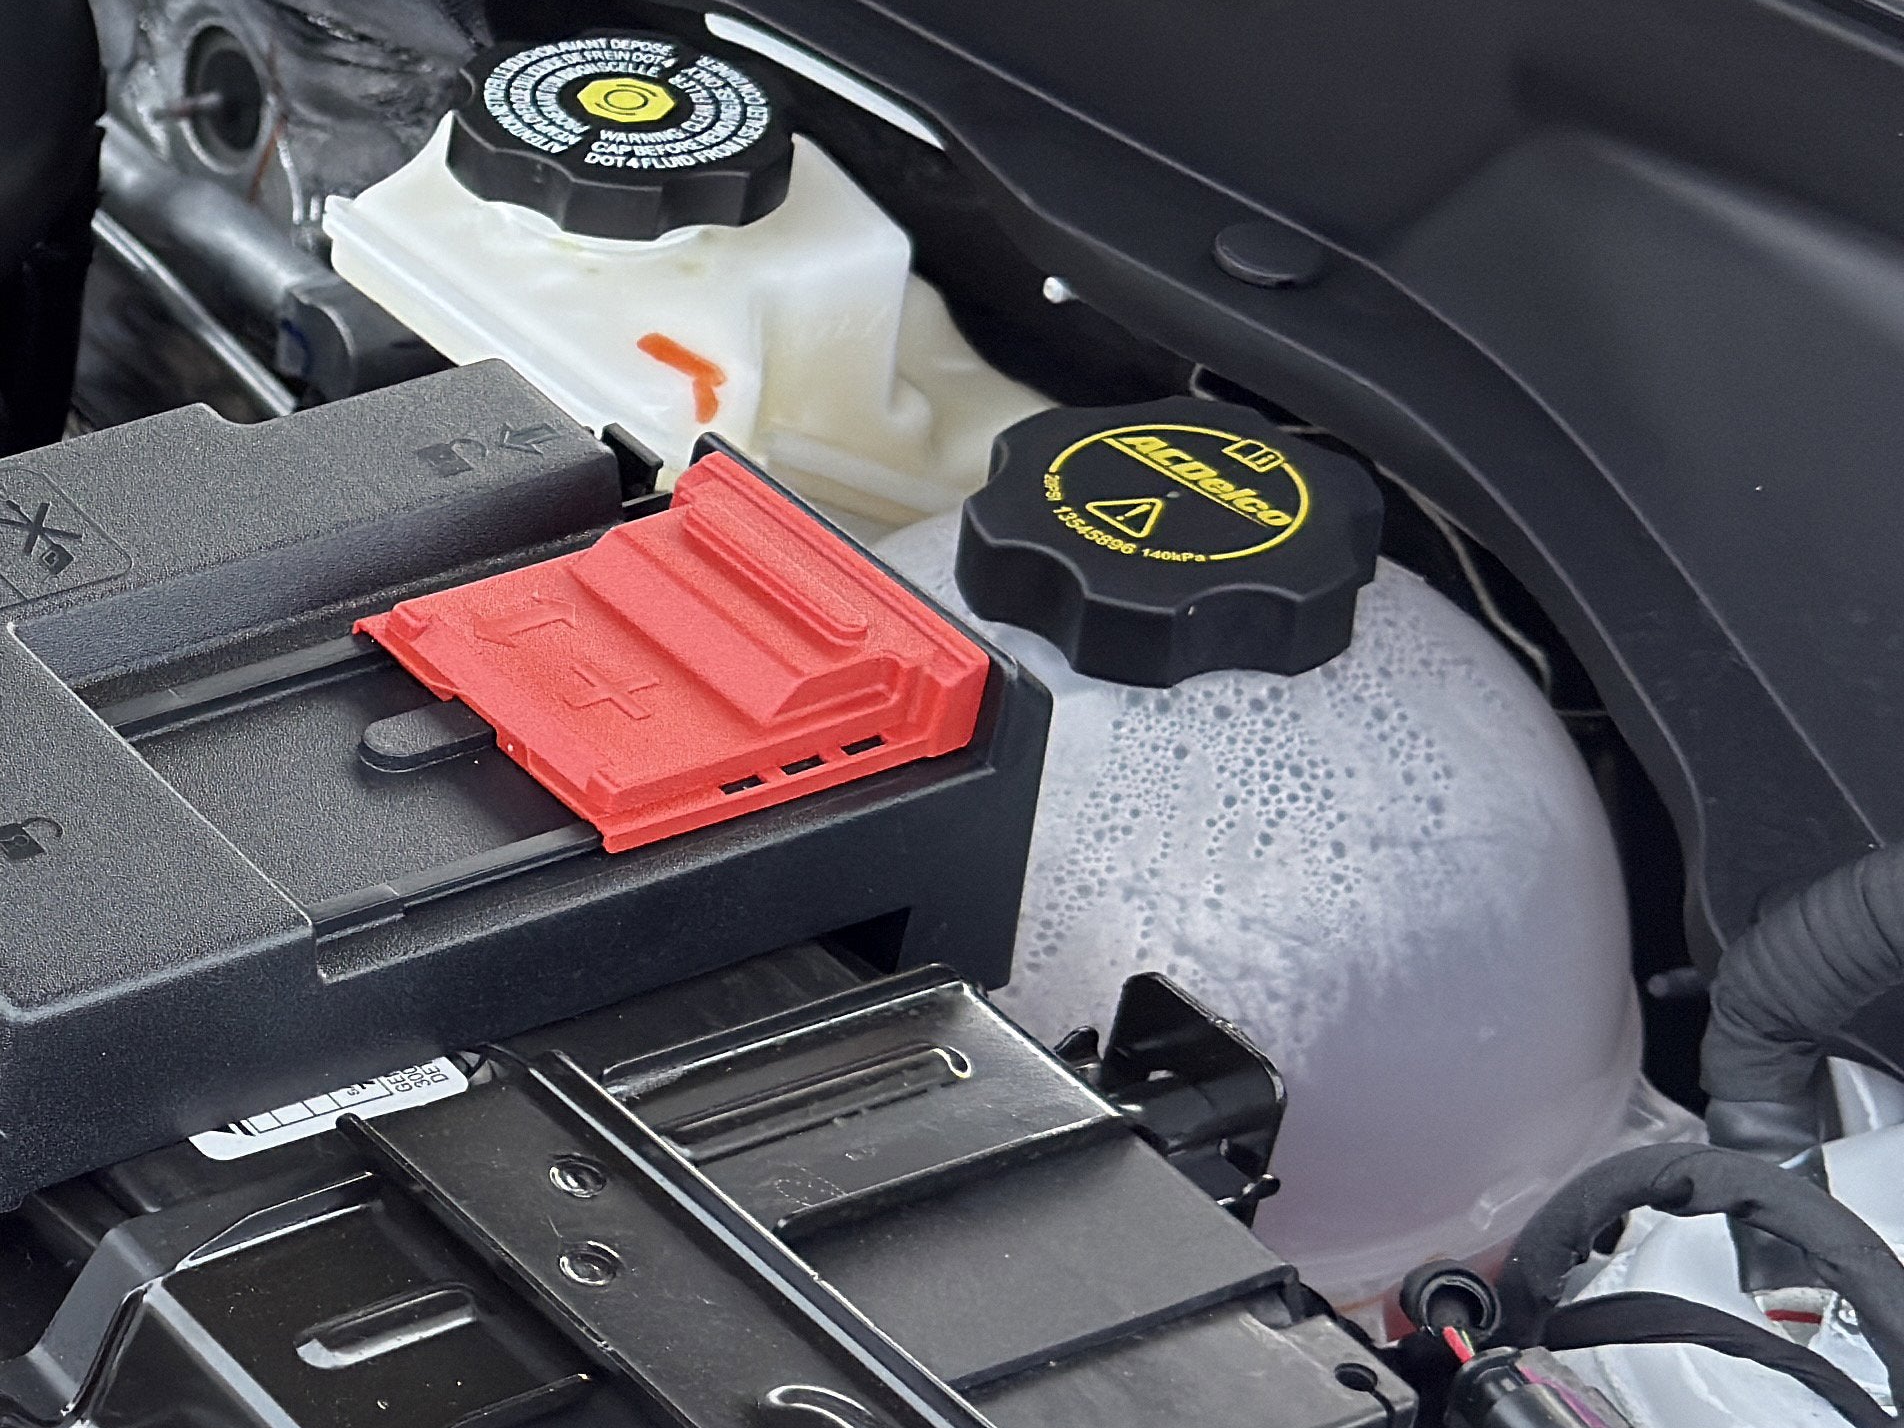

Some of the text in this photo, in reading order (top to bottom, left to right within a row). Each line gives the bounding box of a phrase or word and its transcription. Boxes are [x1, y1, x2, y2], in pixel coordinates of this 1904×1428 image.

[557, 37, 611, 56] AVANT
[583, 49, 631, 65] FREIN
[631, 51, 666, 68] DOT
[656, 57, 677, 69] 4
[583, 151, 628, 168] DOT
[625, 157, 641, 169] 4
[640, 154, 697, 169] FLUID
[692, 140, 744, 164] FROM
[737, 105, 770, 141] SEALED
[590, 140, 633, 155] CAP
[632, 138, 705, 157] BEFORE
[1119, 435, 1292, 528] ACDelco
[1052, 505, 1138, 555] 13545896
[1141, 547, 1207, 562] 140kPa
